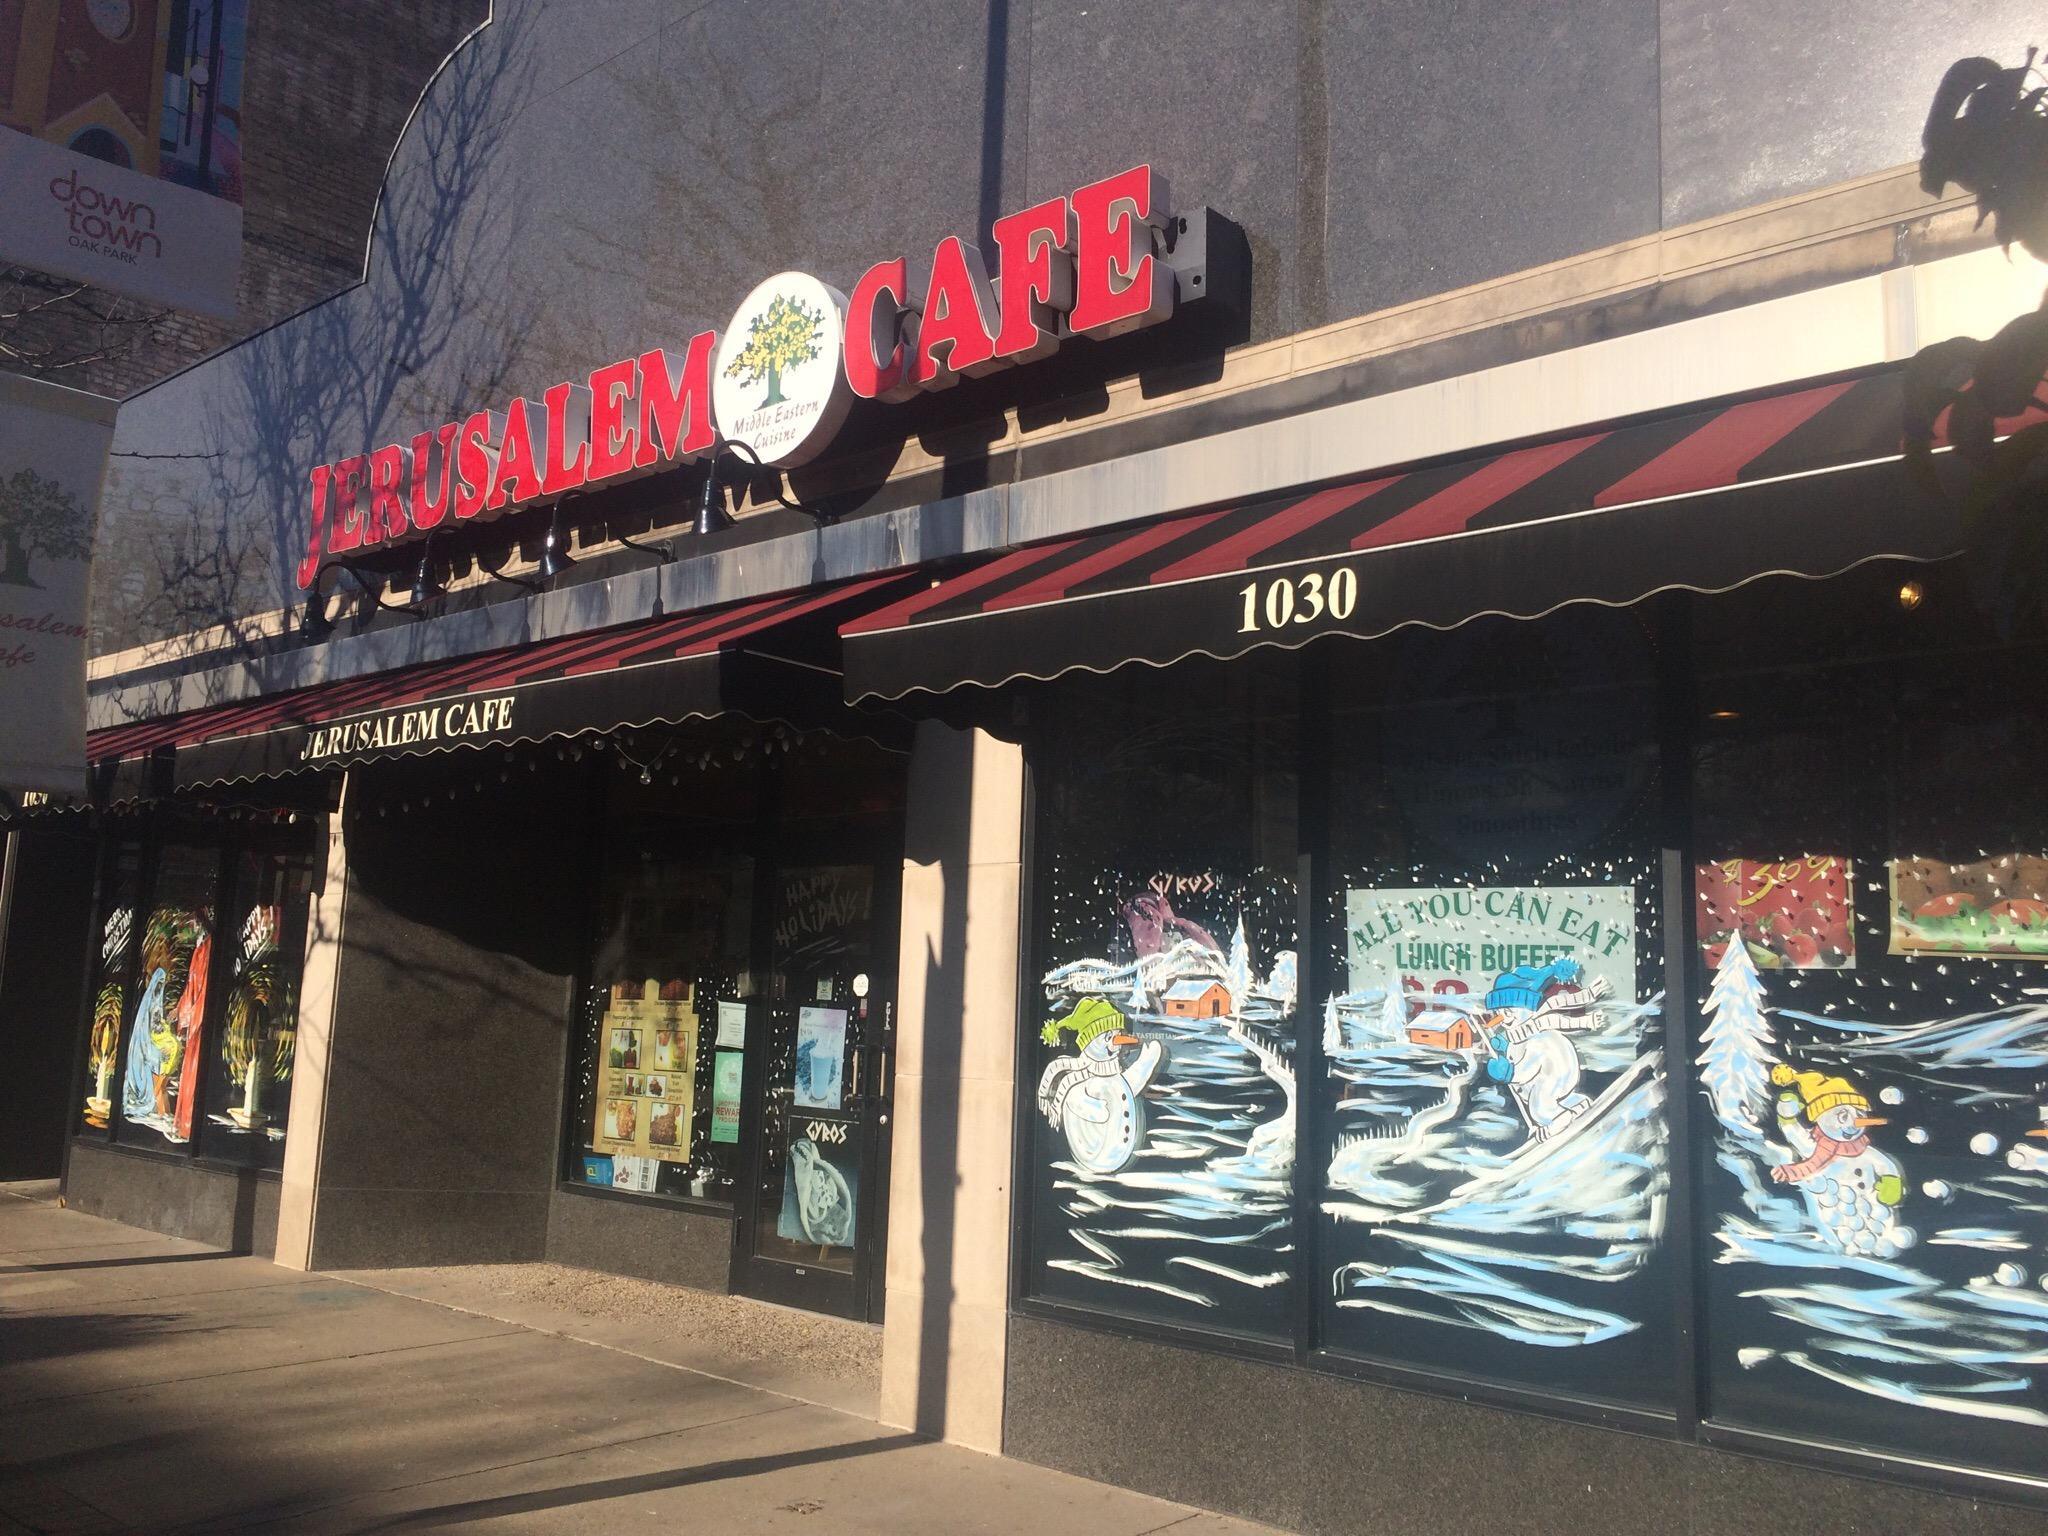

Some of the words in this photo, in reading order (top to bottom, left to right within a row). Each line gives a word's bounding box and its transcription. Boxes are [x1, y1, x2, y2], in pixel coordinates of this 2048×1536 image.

[49, 169, 156, 231] down
[63, 201, 162, 259] town
[68, 235, 99, 254] OAK
[103, 245, 138, 266] PARK
[297, 329, 717, 590] JERUSALEM
[843, 163, 1155, 399] CAFE
[732, 409, 771, 437] Middle
[774, 399, 820, 424] Eastern
[752, 426, 797, 450] Cuisine
[1236, 566, 1358, 634] 1030
[300, 706, 442, 761] JERUSALEM
[444, 696, 516, 737] CAFE
[785, 871, 840, 907] HAPPY
[1352, 911, 1403, 952] ALL
[1408, 890, 1473, 925] YOU
[1484, 890, 1552, 925] CAN
[1557, 906, 1629, 957] EAT
[1395, 942, 1471, 971] LUNCH
[805, 1120, 848, 1145] GYROS
